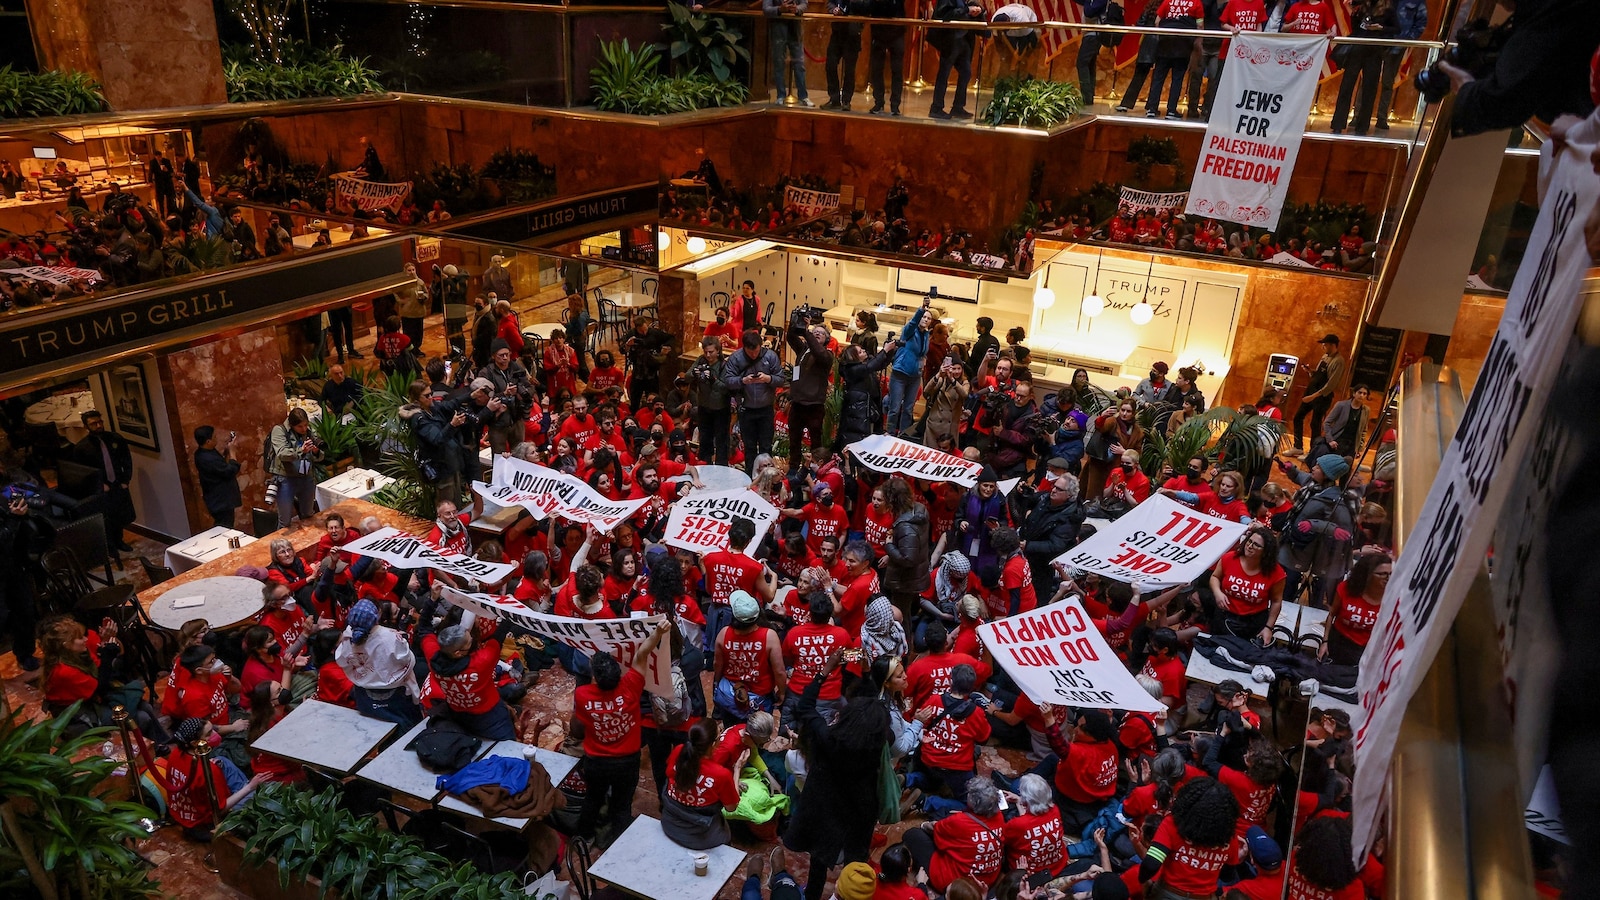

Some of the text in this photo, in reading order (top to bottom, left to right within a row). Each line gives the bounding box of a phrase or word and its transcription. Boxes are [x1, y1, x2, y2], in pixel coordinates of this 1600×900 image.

[1236, 90, 1282, 114] JEWS
[1236, 115, 1270, 137] FOR
[1210, 136, 1287, 161] PALESTINIAN
[1202, 154, 1281, 185] FREEDOM
[336, 180, 359, 194] FREE
[787, 188, 812, 204] FREE
[1110, 280, 1170, 296] TRUMP
[12, 290, 234, 358] TRUMP GRILL
[856, 450, 918, 469] DEPORT
[886, 442, 975, 469] MOVEMENT
[916, 462, 968, 480] CAN'T
[492, 486, 510, 498] IS
[580, 496, 628, 516] JEWISH
[684, 498, 770, 520] STUDENTS
[682, 516, 732, 533] AZIS
[865, 526, 881, 538] OUR
[878, 523, 888, 532] IN
[1156, 511, 1222, 548] ALL
[360, 538, 422, 558] AGAIN
[1126, 530, 1200, 564] FACE US
[454, 557, 498, 576] FOR
[1071, 552, 1110, 570] FOR
[1108, 542, 1172, 574] ONE,
[713, 564, 743, 576] JEWS
[716, 574, 738, 584] SAY
[1228, 575, 1249, 587] NOT
[1230, 584, 1259, 598] OUR
[791, 606, 806, 615] NOT
[990, 606, 1087, 644] COMPLY
[725, 640, 762, 651] JEWS
[794, 634, 835, 646] JEWS
[729, 652, 758, 660] SAY
[799, 646, 829, 656] SAY
[1009, 644, 1059, 666] NOT
[1060, 637, 1100, 664] DO
[728, 660, 759, 668] STOP
[930, 667, 954, 678] JEW
[440, 680, 473, 692] SAY
[935, 677, 954, 686] SA
[1050, 668, 1094, 688] SAY
[442, 686, 475, 699] STOP
[585, 695, 624, 710] JEWS
[591, 708, 623, 722] SAY
[593, 713, 629, 730] STOP
[972, 827, 1003, 842] JEWS
[1024, 820, 1059, 839] JEWS
[1030, 840, 1061, 857] STOP
[1031, 831, 1059, 849] SAY
[1179, 845, 1229, 861] ARMING
[972, 859, 1000, 870] ARMIN
[1175, 853, 1223, 871] ISRAEL
